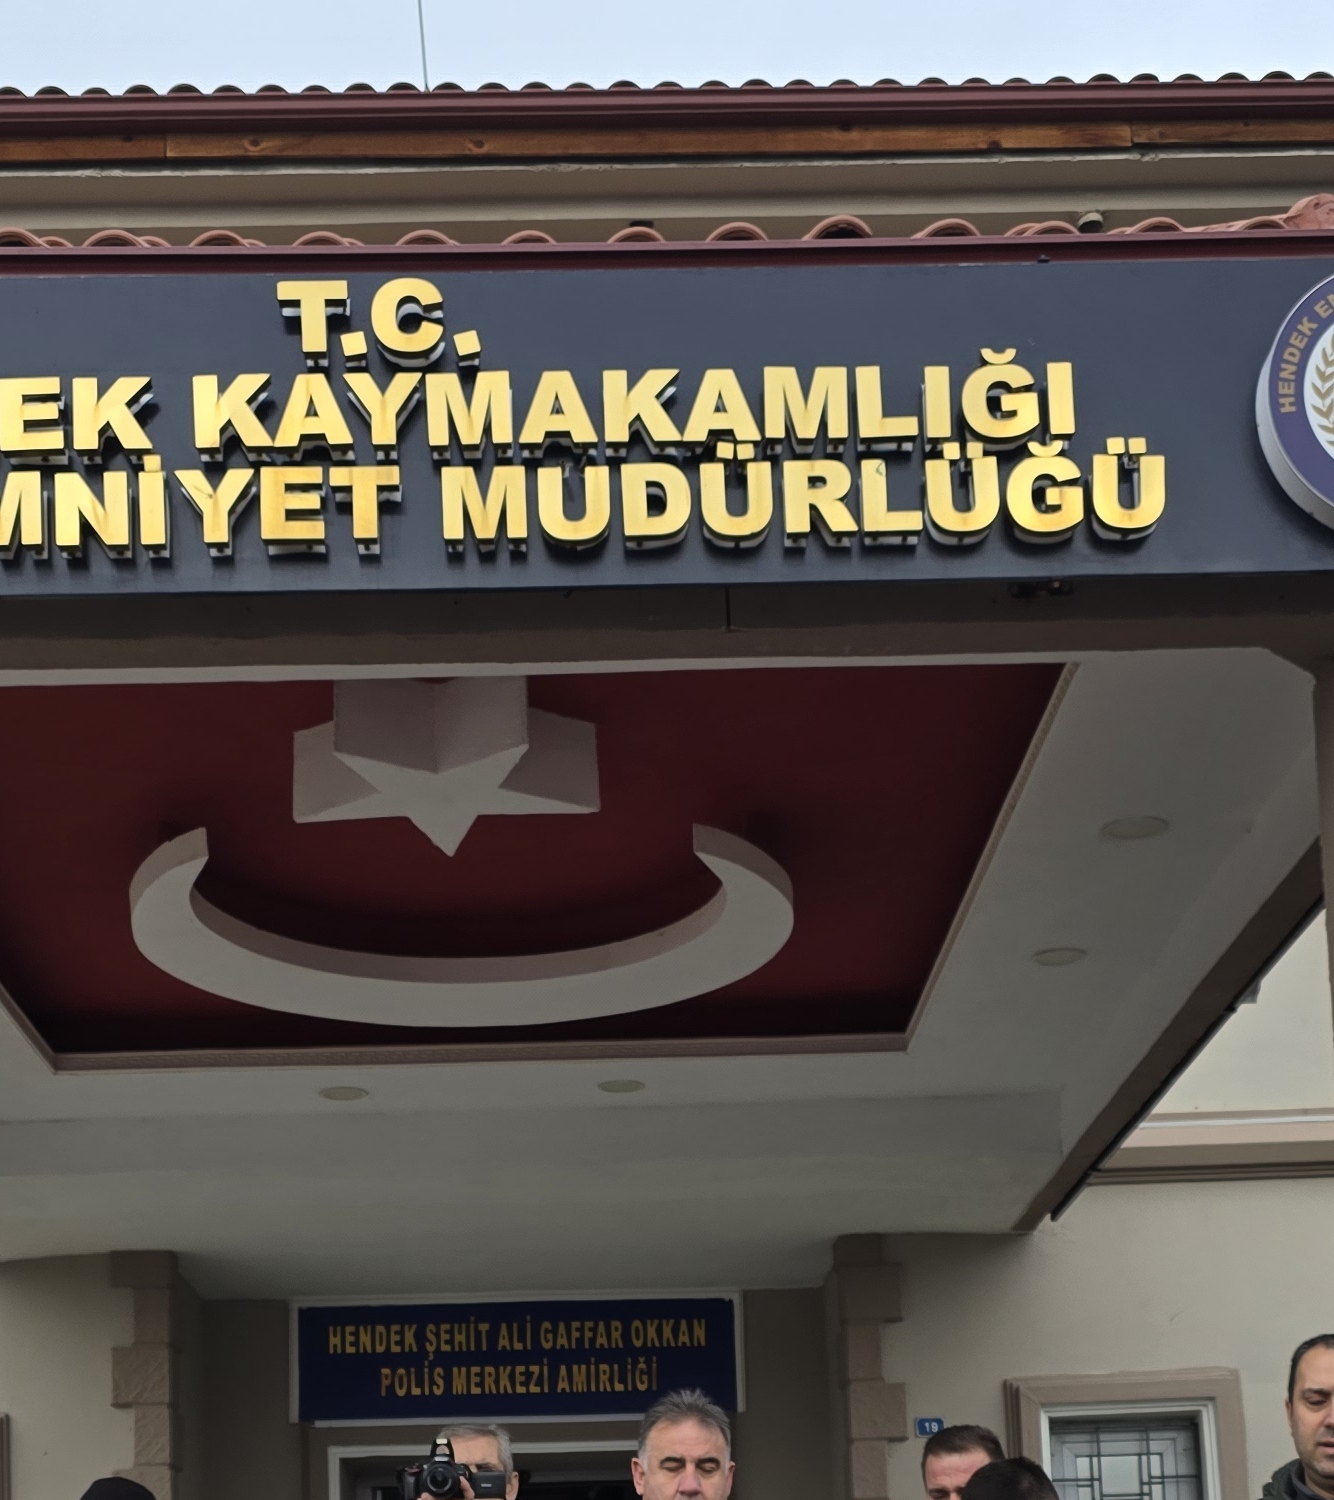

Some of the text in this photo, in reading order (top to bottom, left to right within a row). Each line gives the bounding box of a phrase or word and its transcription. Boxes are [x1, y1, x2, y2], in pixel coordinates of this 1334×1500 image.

[278, 278, 479, 355] T.C.
[1278, 316, 1319, 413] HENDEK
[194, 350, 1075, 448] KAYMAKAMLIĞI
[328, 1315, 706, 1360] HENDEK ŞEHİT ALİ GAFFAR OKKAN
[380, 1356, 658, 1397] POLİS MERKEZİ AMİRLİĞİ
[924, 1421, 939, 1433] 19
